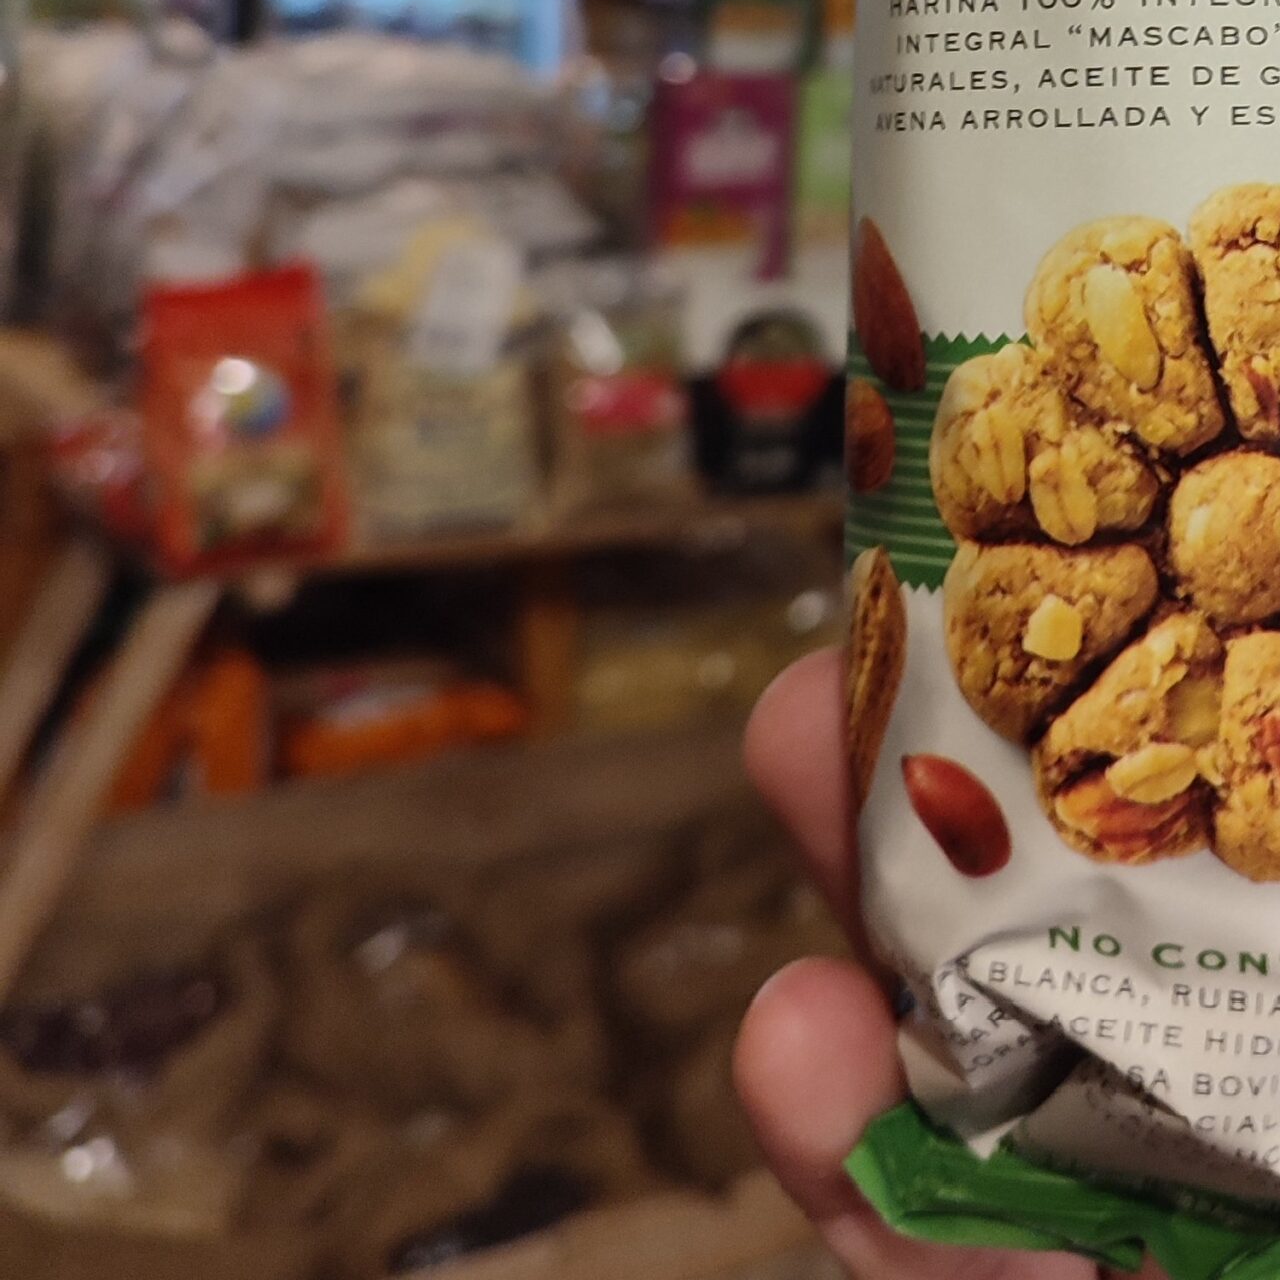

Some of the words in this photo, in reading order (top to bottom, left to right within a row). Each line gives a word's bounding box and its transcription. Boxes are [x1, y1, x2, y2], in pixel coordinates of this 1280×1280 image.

[897, 28, 1051, 54] INTEGRAL
[1038, 66, 1171, 88] ACEITE
[1191, 65, 1241, 87] DE
[875, 110, 947, 132] AVENA
[961, 106, 1171, 131] ARROLLADA
[1191, 105, 1209, 127] Y
[1049, 926, 1122, 958] NO
[989, 961, 1151, 1007] BLANCA,
